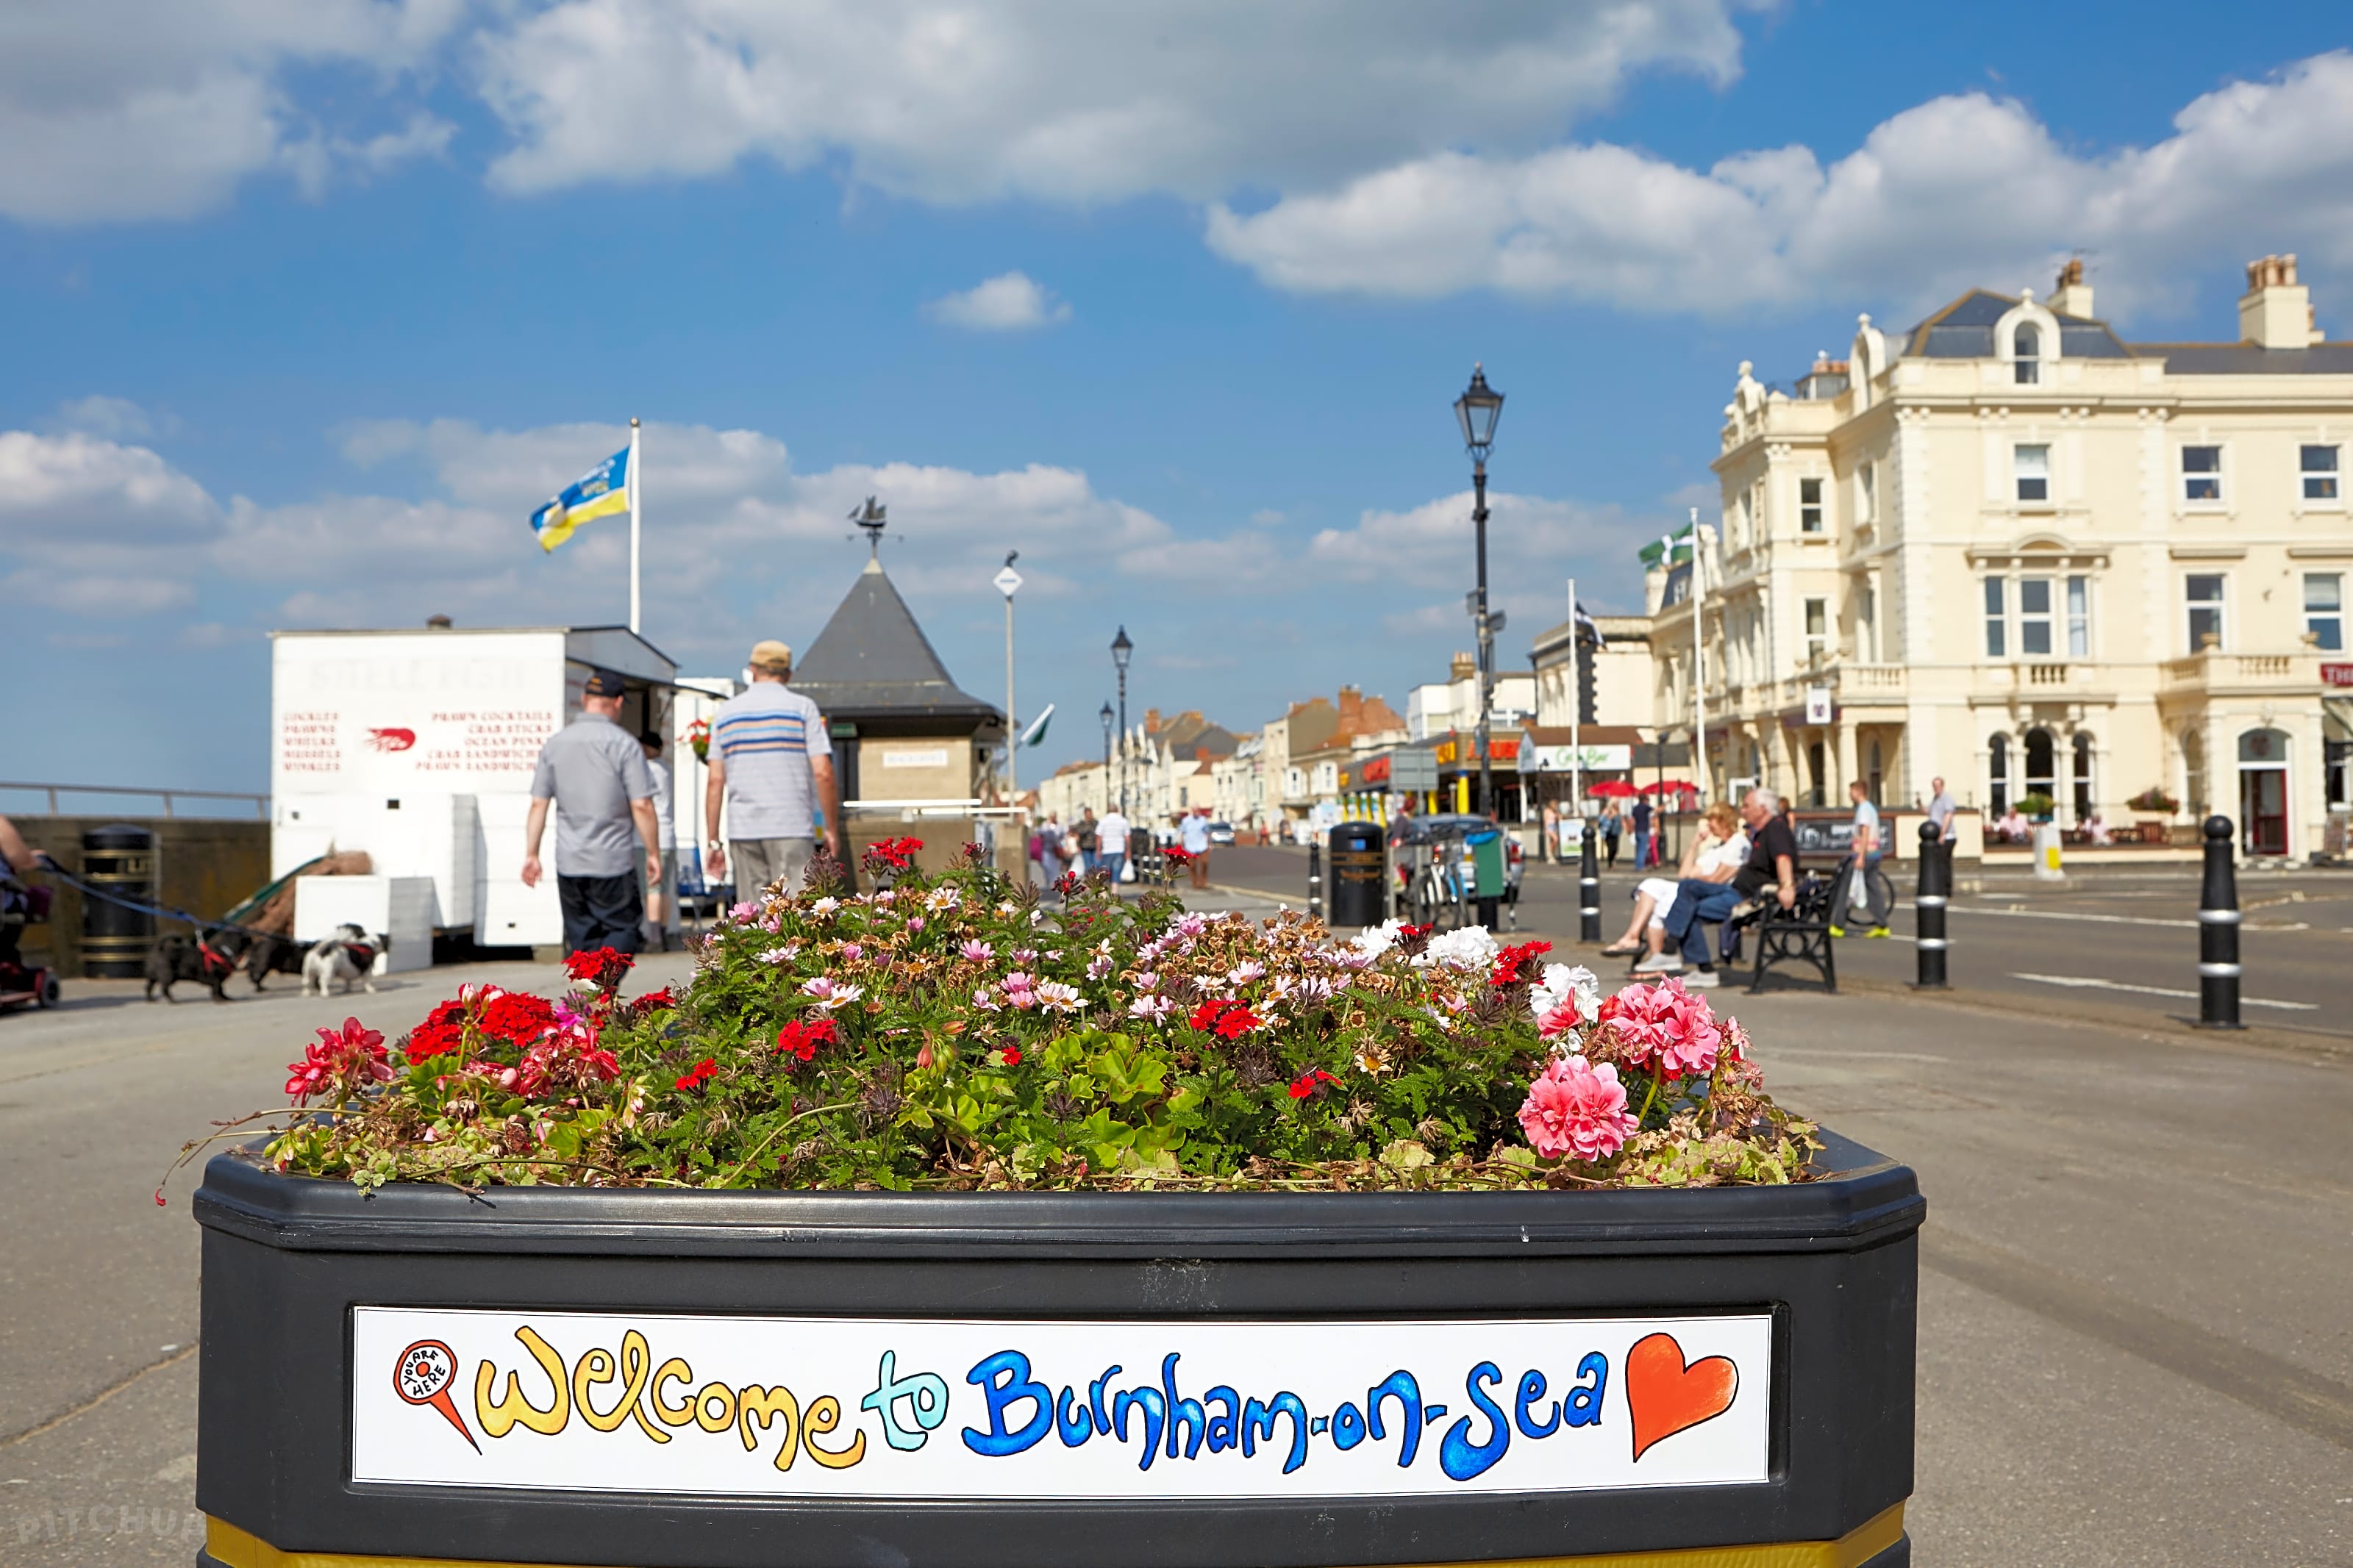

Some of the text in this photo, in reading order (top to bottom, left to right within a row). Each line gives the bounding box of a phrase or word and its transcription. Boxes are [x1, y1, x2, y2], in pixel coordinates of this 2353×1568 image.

[432, 712, 552, 721] PRAWN COCKTAILS
[468, 724, 551, 734] CRAB STICKS
[512, 737, 542, 745] PINK
[428, 750, 460, 759] CRAB
[415, 762, 460, 770] PRAWN
[404, 1350, 446, 1396] YOU ARE HERE
[474, 1325, 1609, 1482] Welcome to Burnham-on-Sea
